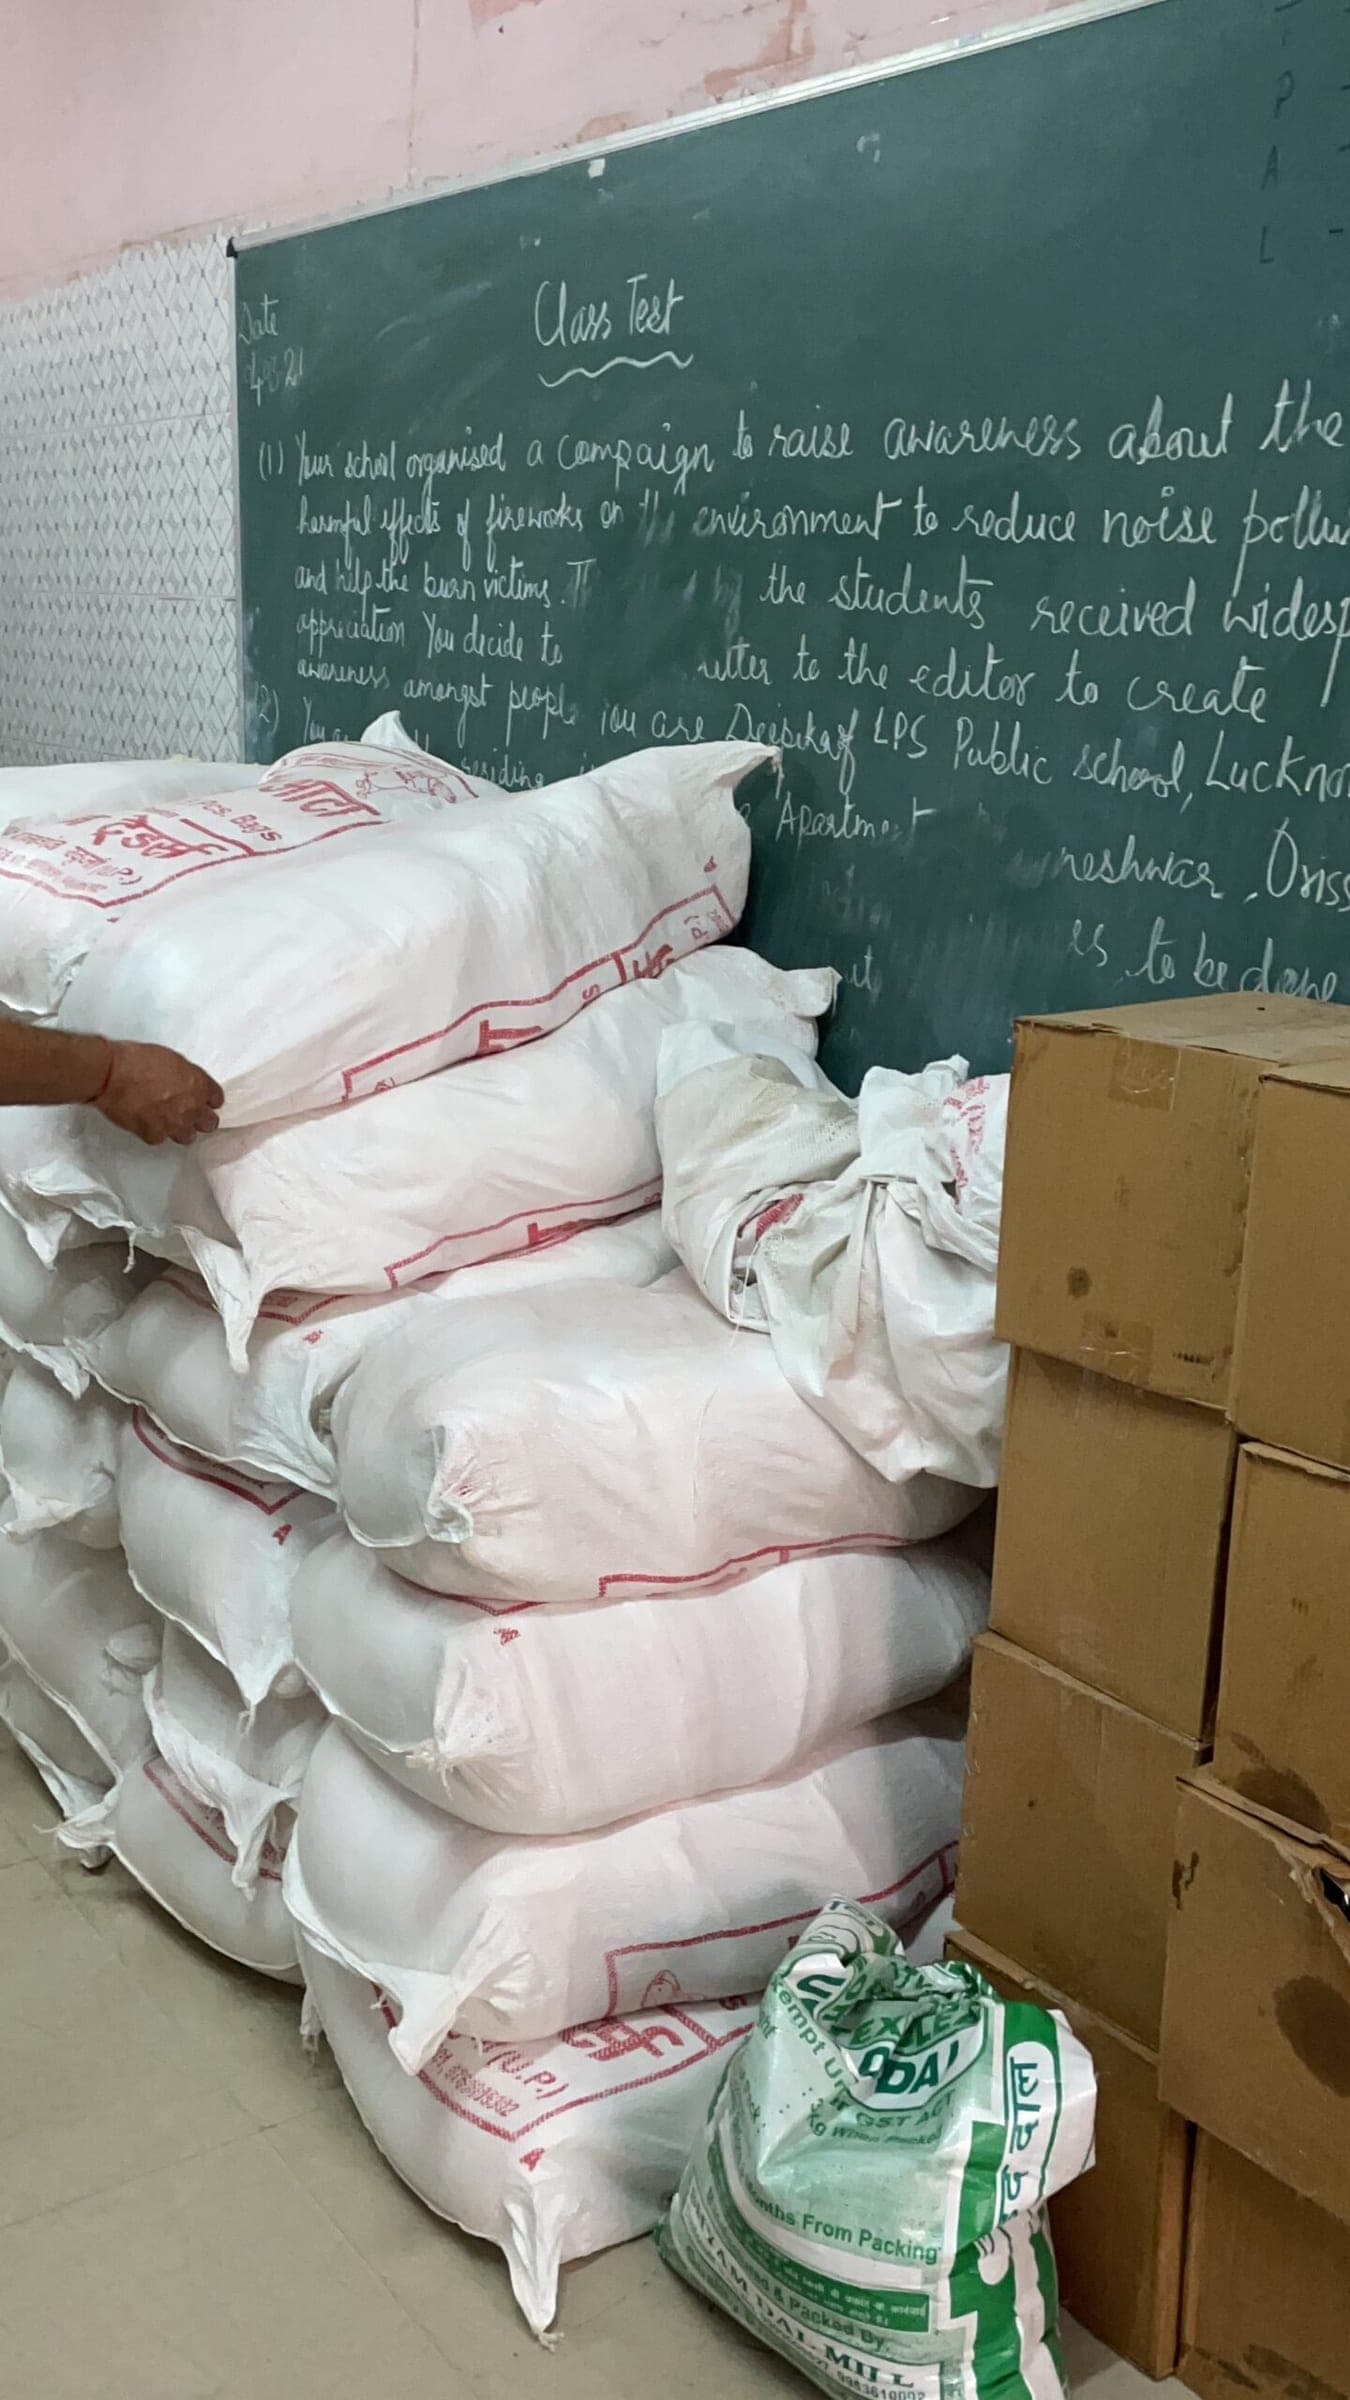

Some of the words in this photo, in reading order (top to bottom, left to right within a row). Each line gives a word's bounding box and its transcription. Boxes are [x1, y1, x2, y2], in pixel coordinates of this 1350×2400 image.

[534, 280, 611, 347] Class
[626, 273, 685, 336] Test
[527, 440, 544, 467] a
[733, 409, 753, 460] to
[768, 404, 854, 460] raise
[884, 413, 1082, 461] awareness
[1108, 391, 1234, 465] about
[1258, 377, 1345, 453] the
[912, 485, 939, 537] to
[952, 489, 1076, 545] reduce
[1102, 485, 1218, 550] noise
[1232, 485, 1350, 598] pollu
[295, 561, 327, 595] and
[375, 561, 410, 594] the
[759, 561, 807, 605] the
[828, 553, 995, 630] students
[1029, 576, 1197, 638] received
[422, 610, 455, 660] You
[463, 613, 524, 662] decide
[541, 620, 564, 667] to
[793, 632, 822, 682] to
[838, 637, 888, 690] the
[909, 641, 1036, 707] editor
[1055, 648, 1099, 705] to
[1127, 655, 1267, 724] create
[297, 654, 391, 690] awareness
[403, 673, 494, 750] amongst
[651, 710, 704, 743] are
[873, 706, 928, 759] LPS
[953, 716, 1052, 785] Public
[1205, 729, 1350, 803] Luckno
[1194, 930, 1229, 990] be
[802, 2212, 853, 2244] From
[857, 2227, 938, 2266] Packing
[822, 2343, 915, 2390] MILL
